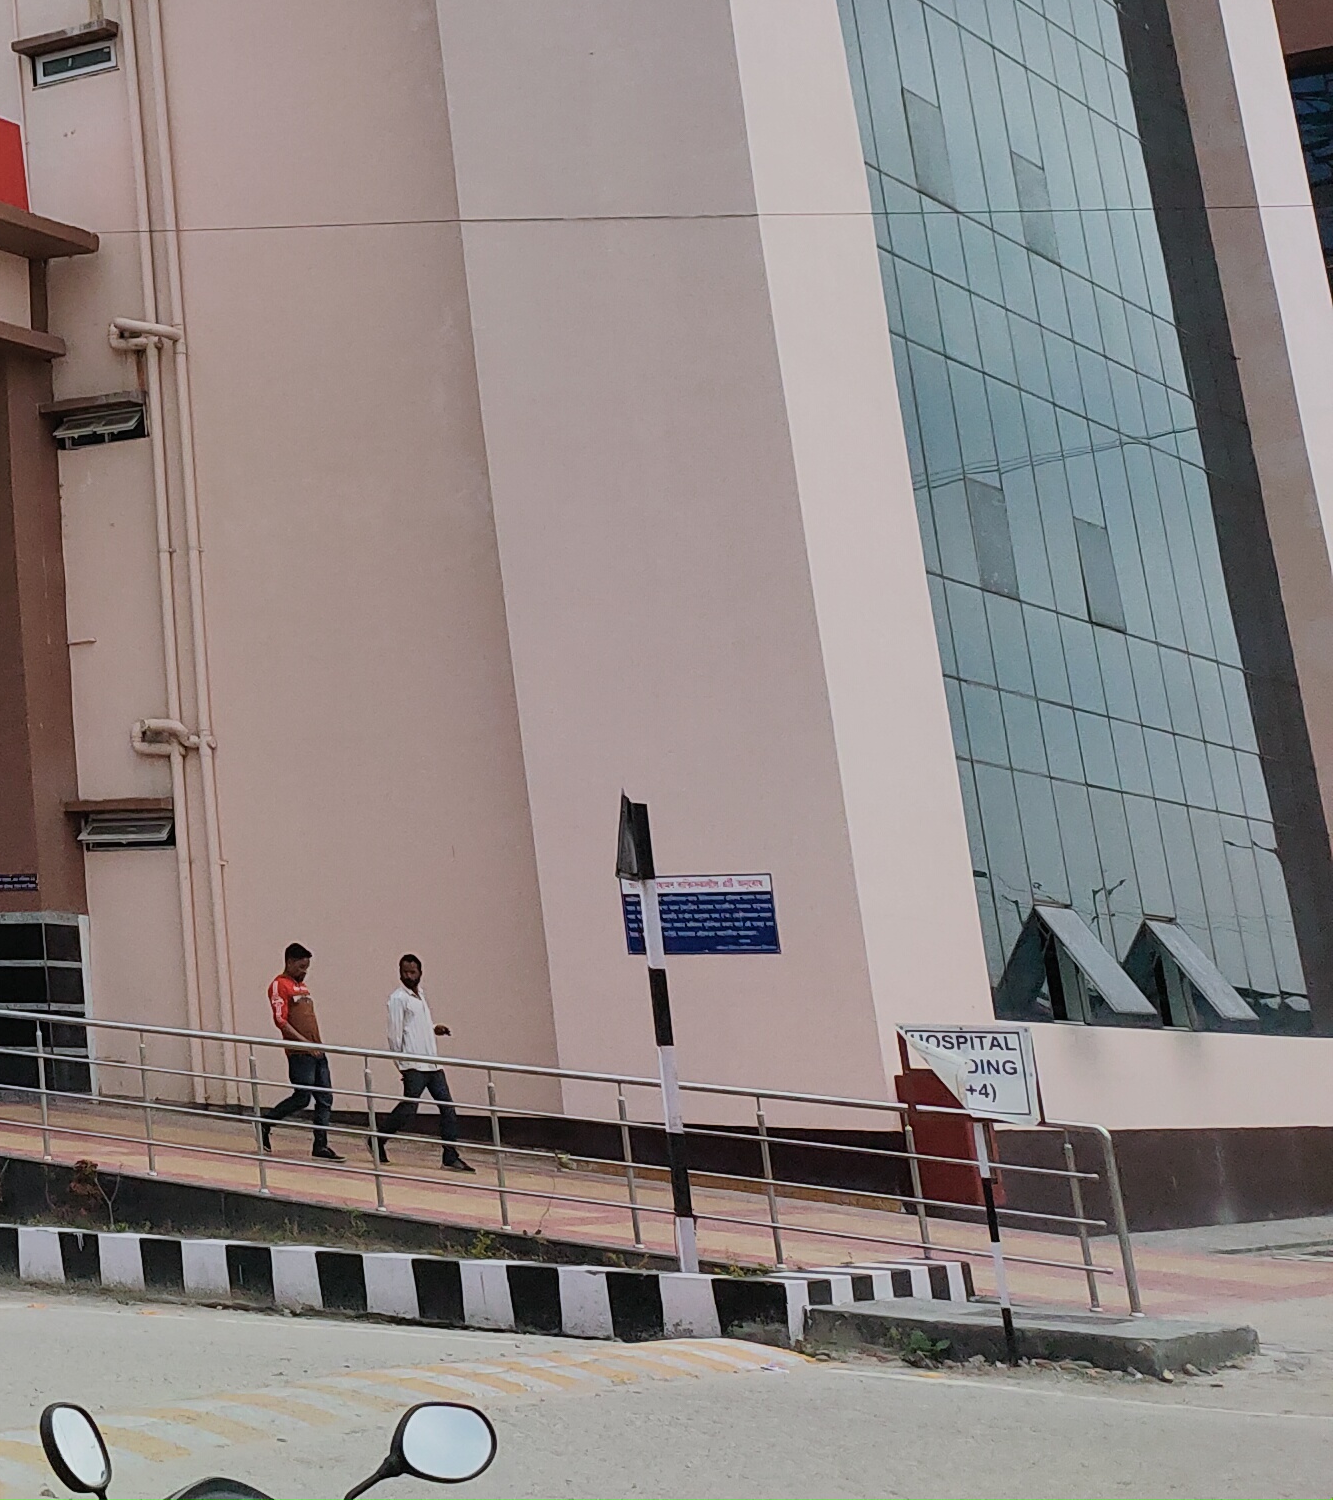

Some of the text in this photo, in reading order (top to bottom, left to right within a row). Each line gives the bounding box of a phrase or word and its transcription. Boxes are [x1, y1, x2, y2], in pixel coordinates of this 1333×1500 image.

[910, 1034, 1017, 1051] OSPITAL
[967, 1058, 1018, 1075] DING
[965, 1083, 997, 1103] +4)
